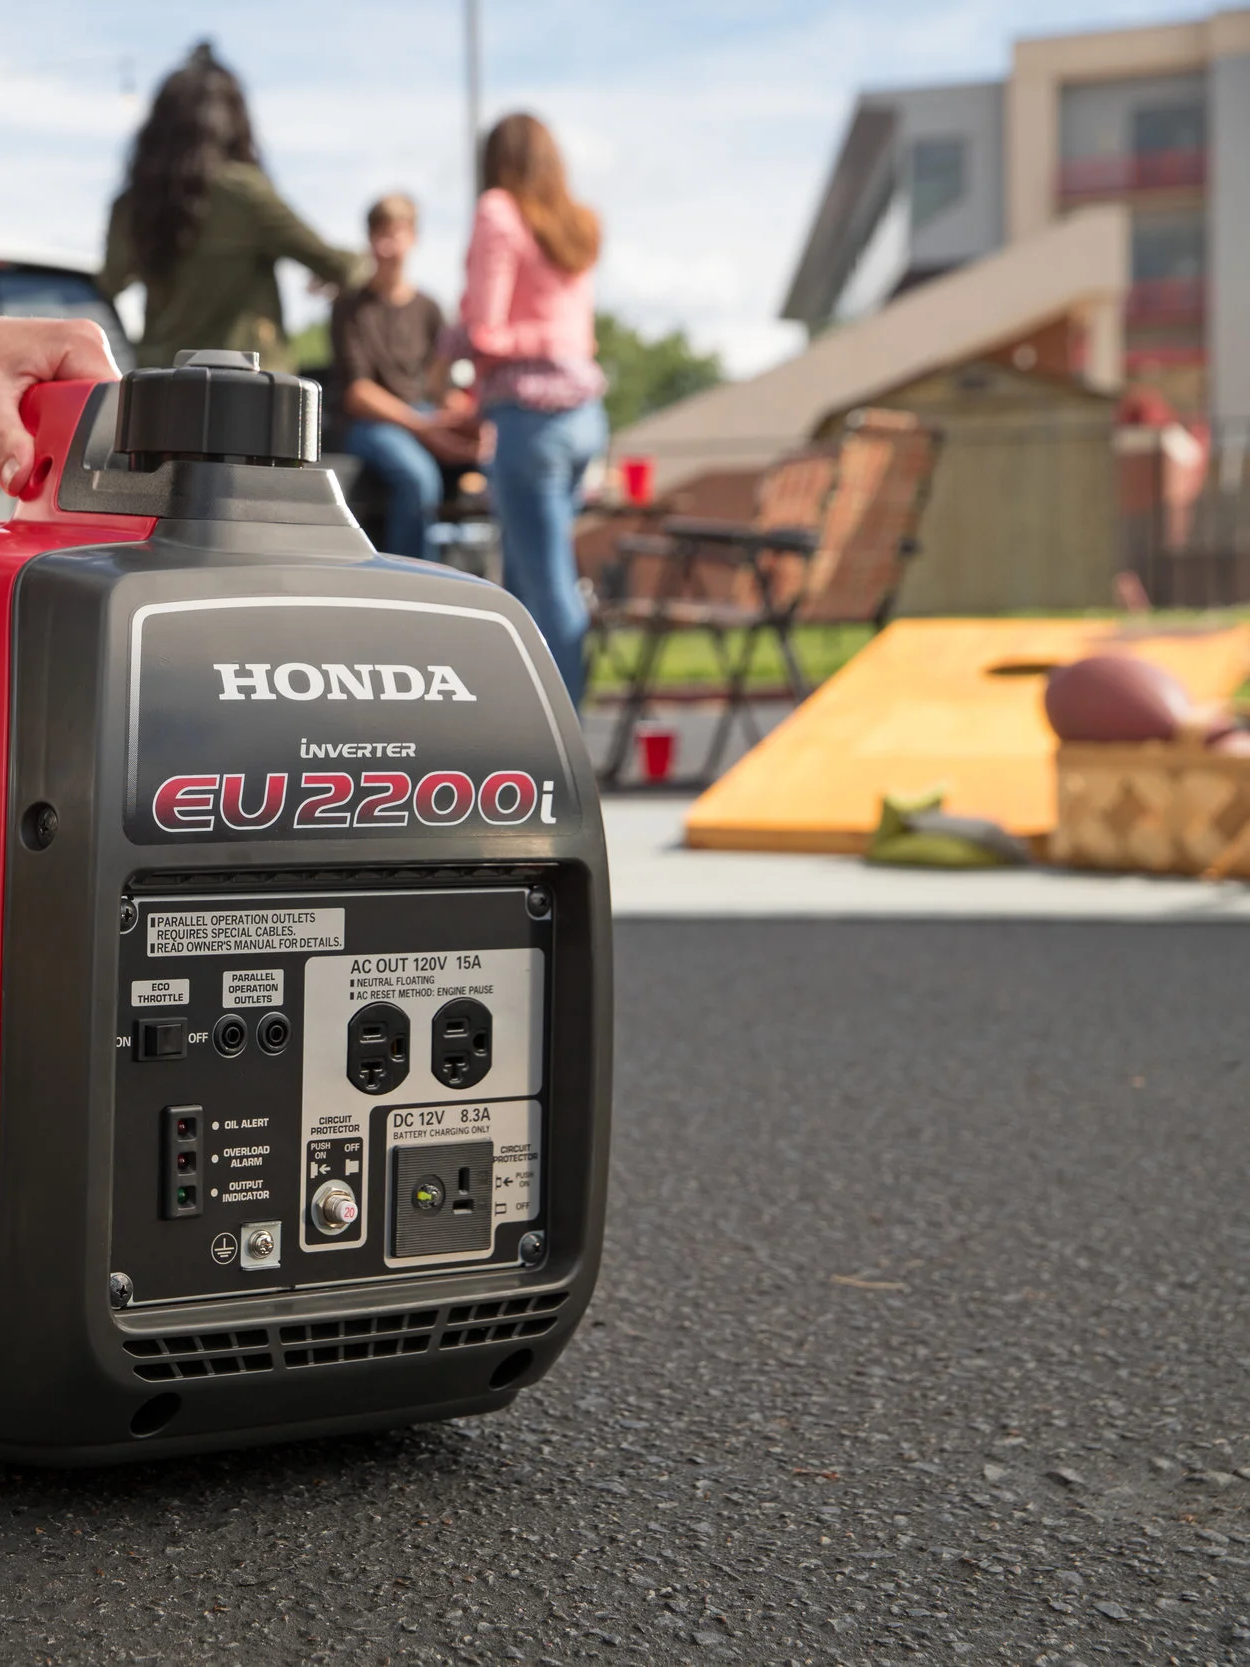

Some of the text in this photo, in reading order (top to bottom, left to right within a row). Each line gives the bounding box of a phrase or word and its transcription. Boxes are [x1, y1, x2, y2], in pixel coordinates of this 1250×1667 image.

[213, 662, 477, 701] HONDA
[157, 912, 316, 928] PARALLEL OPERATION OUTLETS
[157, 926, 296, 942] REQUIRES SPECIAL CABLES.
[156, 936, 342, 954] READ OWNER'S MANUAL FOR DETAILS.
[350, 954, 482, 974] AC OUT 120V 15A
[232, 972, 275, 982] PARALLEL
[356, 975, 435, 988] NEUTRAL FLOATING
[151, 982, 170, 992] ECO
[228, 983, 278, 994] OPERATION
[356, 984, 494, 1000] AC RESET METHOD: ENGINE PAUSE
[138, 993, 184, 1004] THROTTLE
[234, 995, 273, 1005] OUTLETS
[188, 1032, 209, 1044] OFF
[224, 1117, 269, 1130] OIL ALERT
[318, 1114, 352, 1126] CIRCUIT
[393, 1107, 491, 1128] DC 12V 8.3A
[310, 1124, 360, 1136] PROTECTOR
[393, 1125, 491, 1140] BATTERY CHARGING ONLY
[223, 1145, 270, 1157] OVERLOAD
[310, 1141, 331, 1151] PUSH
[344, 1143, 361, 1153] OFF
[500, 1144, 531, 1154] CIRCUIT
[314, 1151, 327, 1160] ON
[493, 1152, 538, 1164] PROTECTOR
[230, 1157, 263, 1168] ALARM
[229, 1179, 264, 1191] OUTPUT
[222, 1190, 270, 1203] INDICATOR
[515, 1202, 531, 1210] OFF
[344, 1207, 355, 1219] 20
